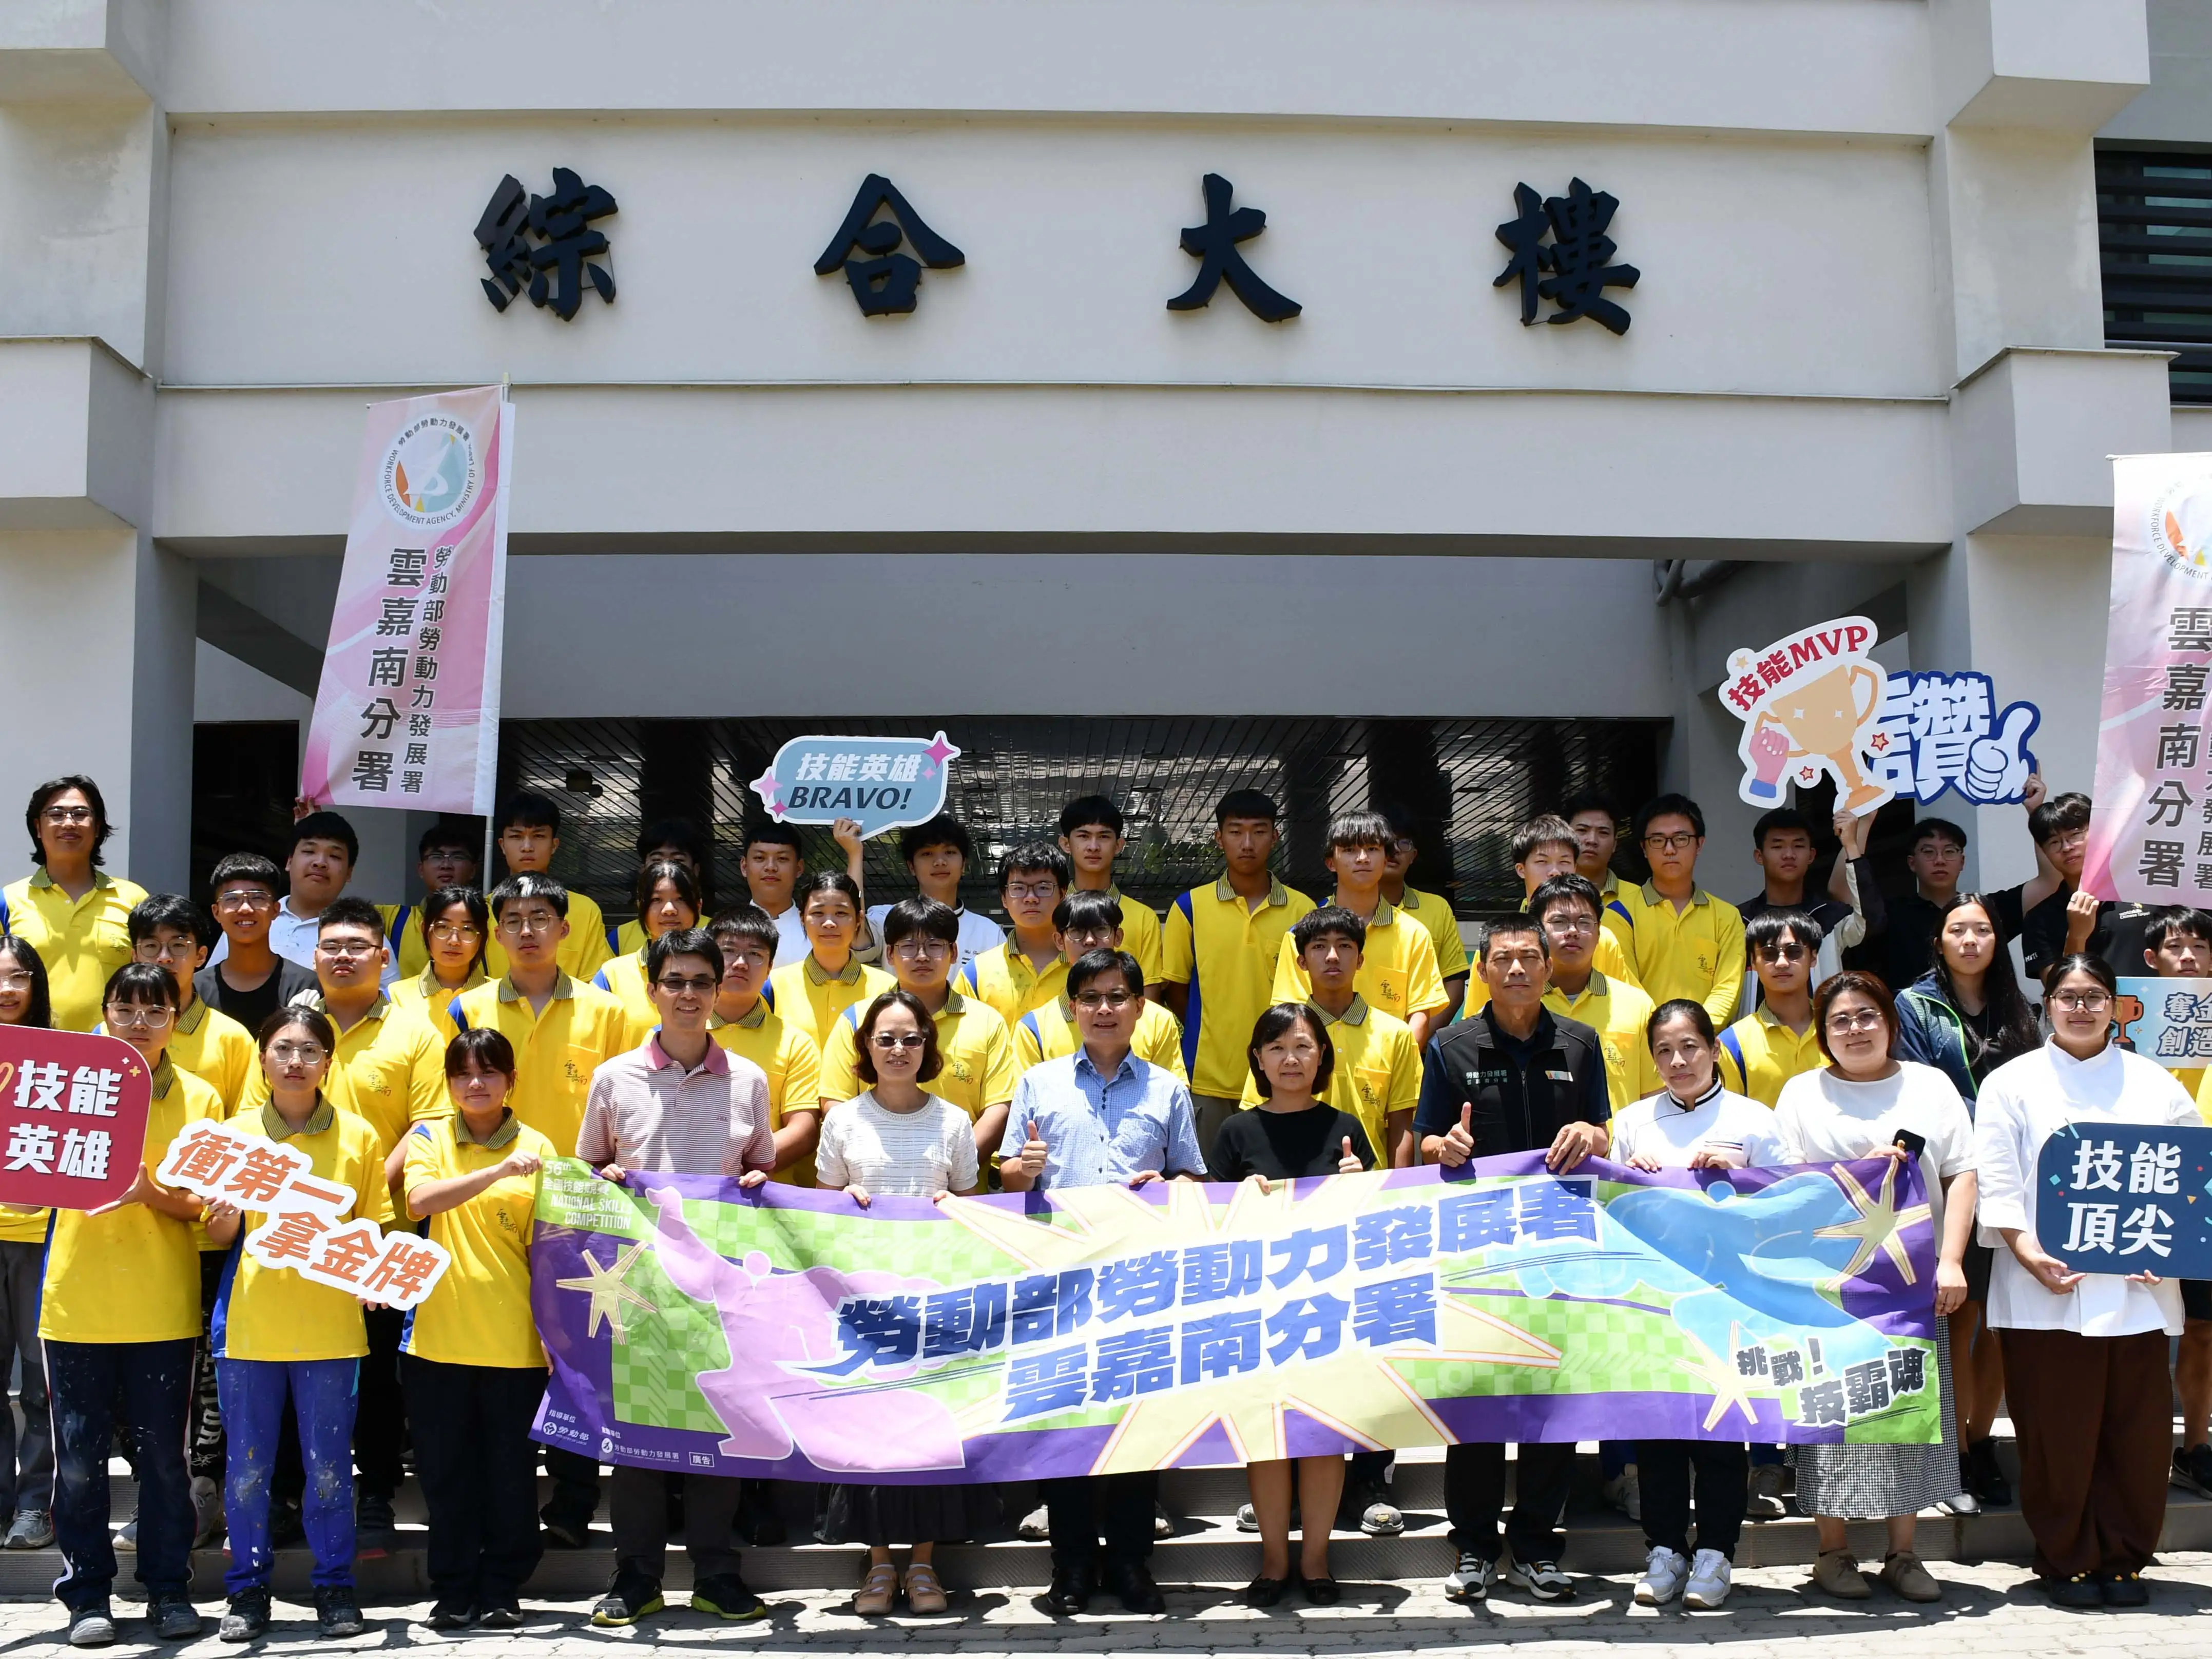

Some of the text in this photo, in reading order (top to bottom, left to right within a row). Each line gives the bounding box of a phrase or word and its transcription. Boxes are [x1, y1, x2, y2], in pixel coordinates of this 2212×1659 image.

[473, 168, 1641, 336] 綜合大樓
[384, 449, 399, 493] WORKFORCE
[455, 480, 475, 513] MINISTRY
[468, 469, 475, 478] OF
[387, 493, 425, 525] DEVELOPMENT
[426, 510, 456, 525] AGENCY,
[2157, 543, 2209, 580] DEVELOPMENT
[352, 548, 427, 792] 雲嘉南分署
[400, 546, 453, 794] 勞動部勞動力發展署
[795, 753, 922, 782] 技能英雄
[2138, 607, 2212, 888] 雲嘉南分署
[788, 786, 912, 810] BRAVO!
[13, 1059, 123, 1117] 技能
[3, 1123, 112, 1180] 英雄
[168, 1129, 345, 1205] 衝第一
[2069, 1140, 2182, 1194] 技能
[551, 1193, 596, 1211] NATIONAL
[564, 1211, 631, 1230] COMPETITION
[256, 1211, 440, 1300] 拿金牌
[2062, 1202, 2175, 1258] 頂尖
[810, 1180, 1597, 1377] 勞動部勞動力發展署
[1000, 1272, 1437, 1423] 雲嘉南分署
[1799, 1347, 1926, 1424] 技霸魂
[614, 1444, 679, 1460] 勞動部勞動力發展署
[693, 1455, 711, 1464] 廣告
